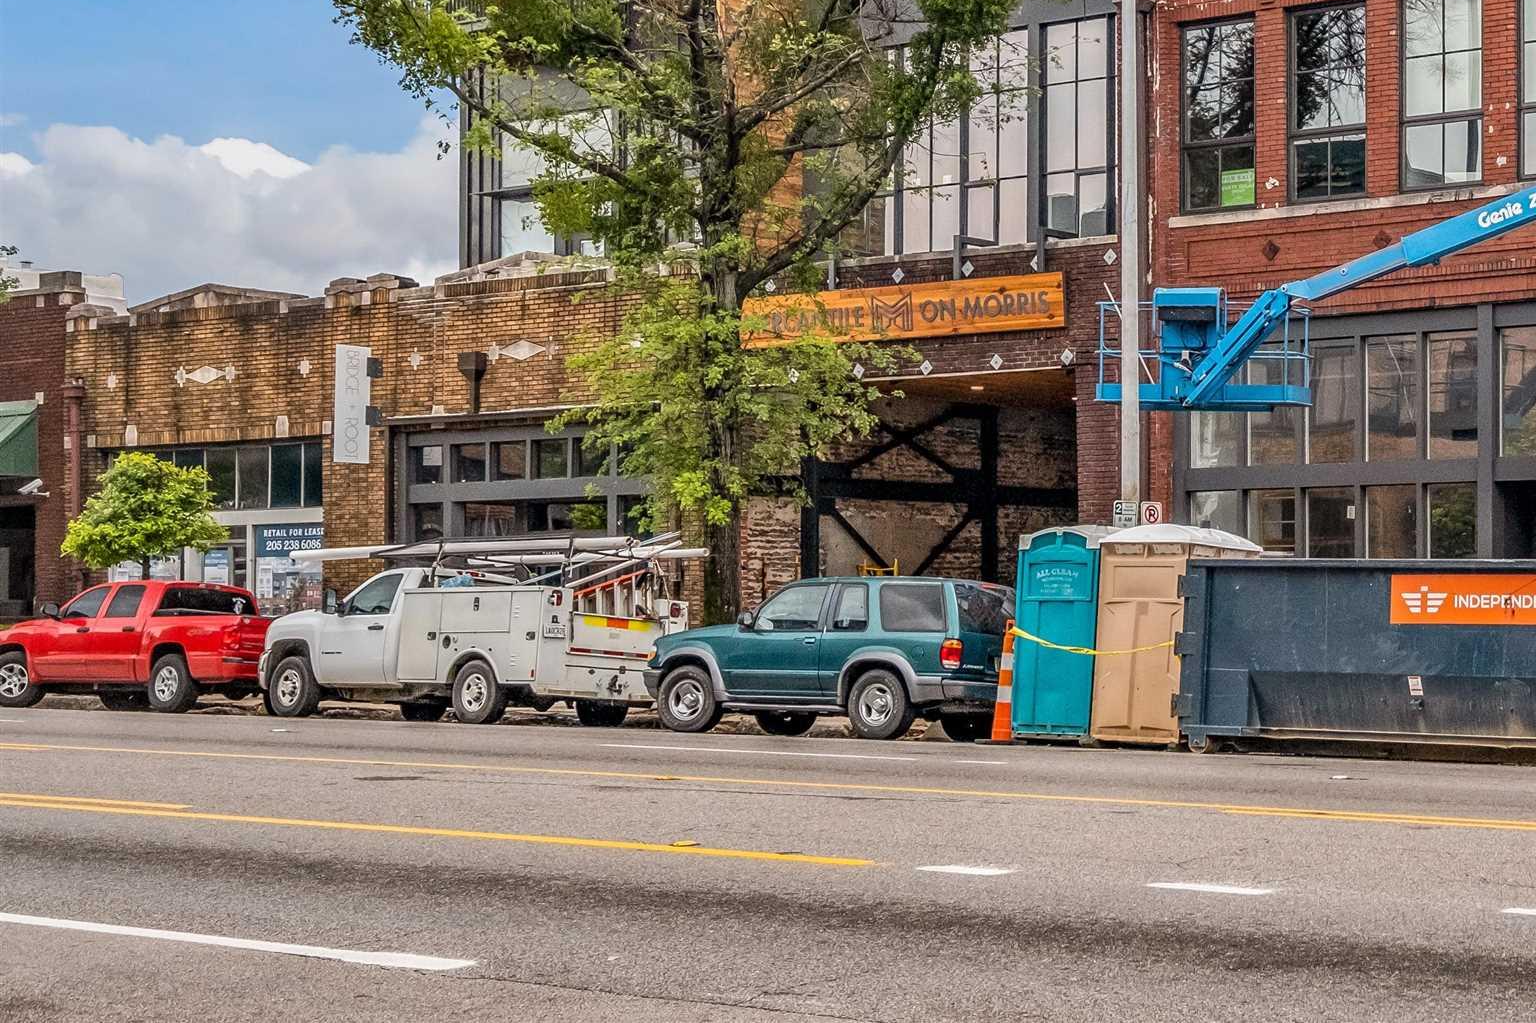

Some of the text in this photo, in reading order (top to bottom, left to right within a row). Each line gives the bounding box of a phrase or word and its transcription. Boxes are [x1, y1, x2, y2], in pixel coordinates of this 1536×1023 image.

[1478, 202, 1524, 228] Genie
[920, 298, 956, 323] ON
[963, 290, 1049, 321] MORRIS
[1115, 503, 1123, 514] 2
[263, 529, 287, 537] RETAIL
[289, 529, 303, 537] FOR
[265, 538, 322, 551] 205 238 6086
